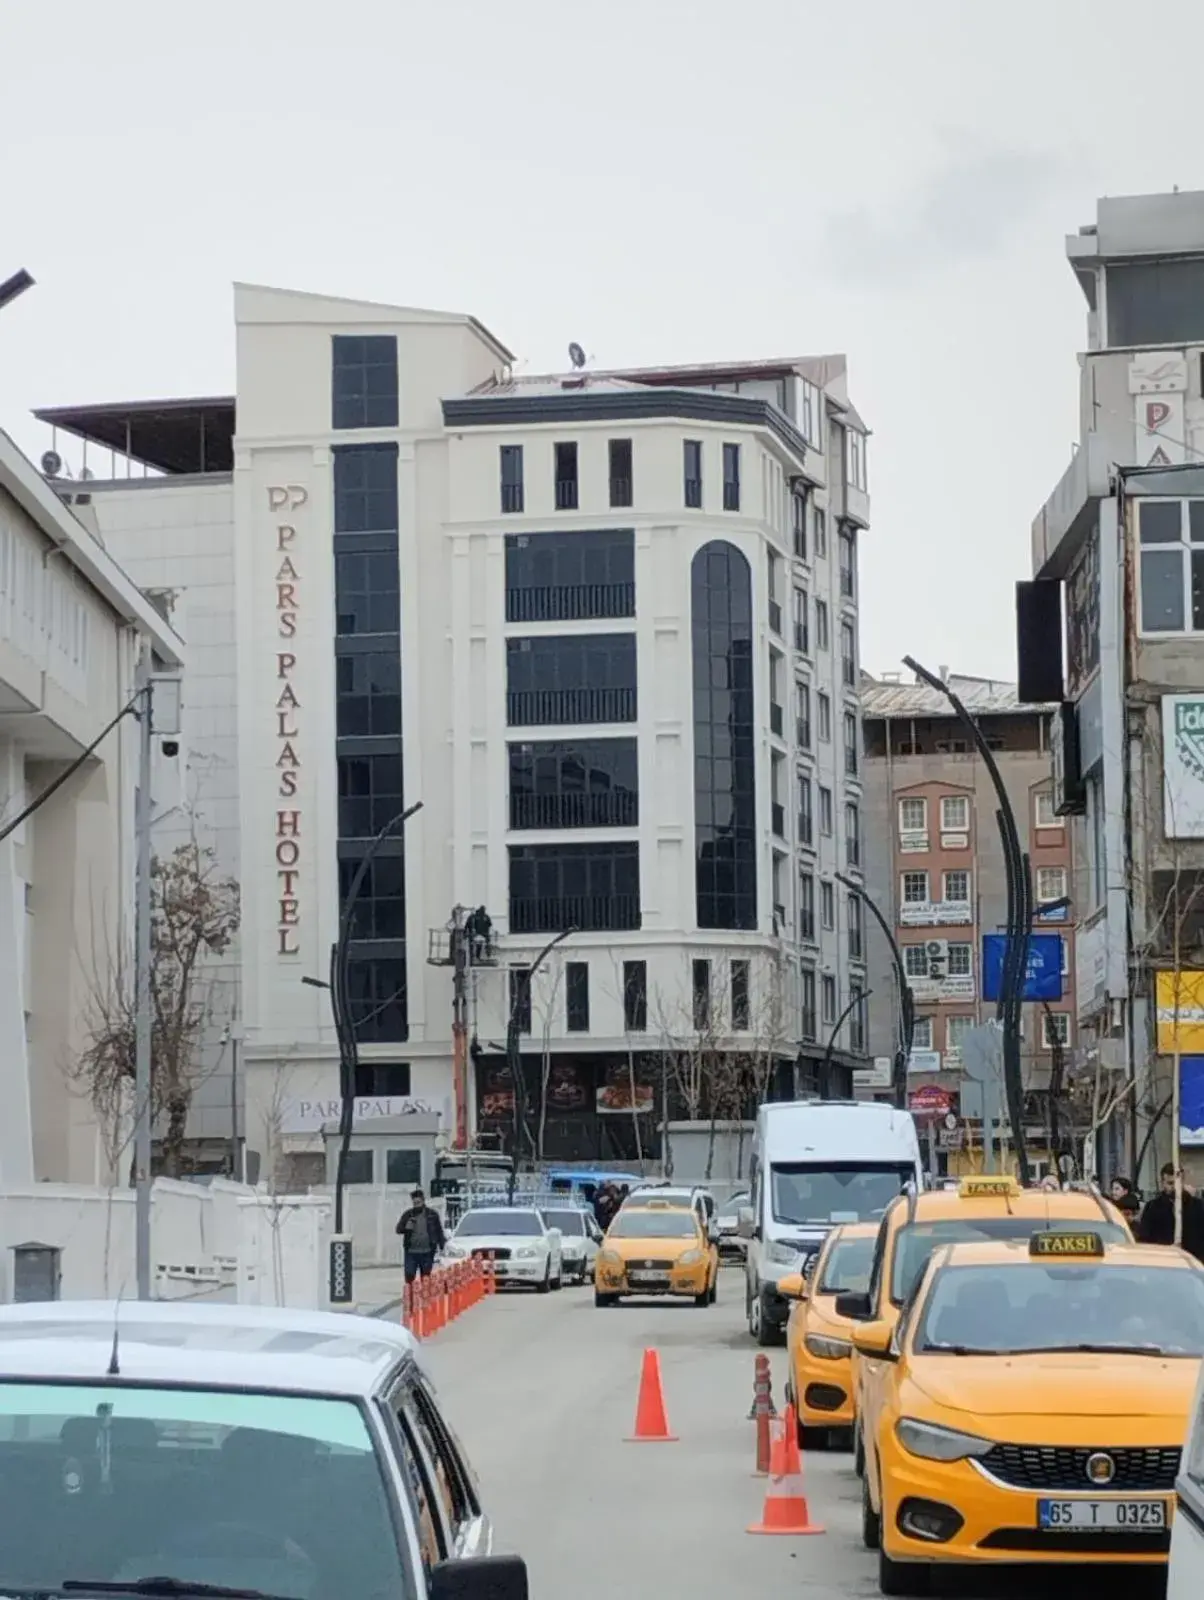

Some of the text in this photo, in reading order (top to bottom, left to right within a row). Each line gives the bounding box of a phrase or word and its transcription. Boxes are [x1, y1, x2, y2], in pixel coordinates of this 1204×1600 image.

[275, 525, 302, 956] PARS PALAS HOTEL
[300, 1100, 342, 1118] PAR
[1050, 1503, 1073, 1524] 65
[1089, 1503, 1099, 1524] T
[1116, 1503, 1161, 1524] 0325
